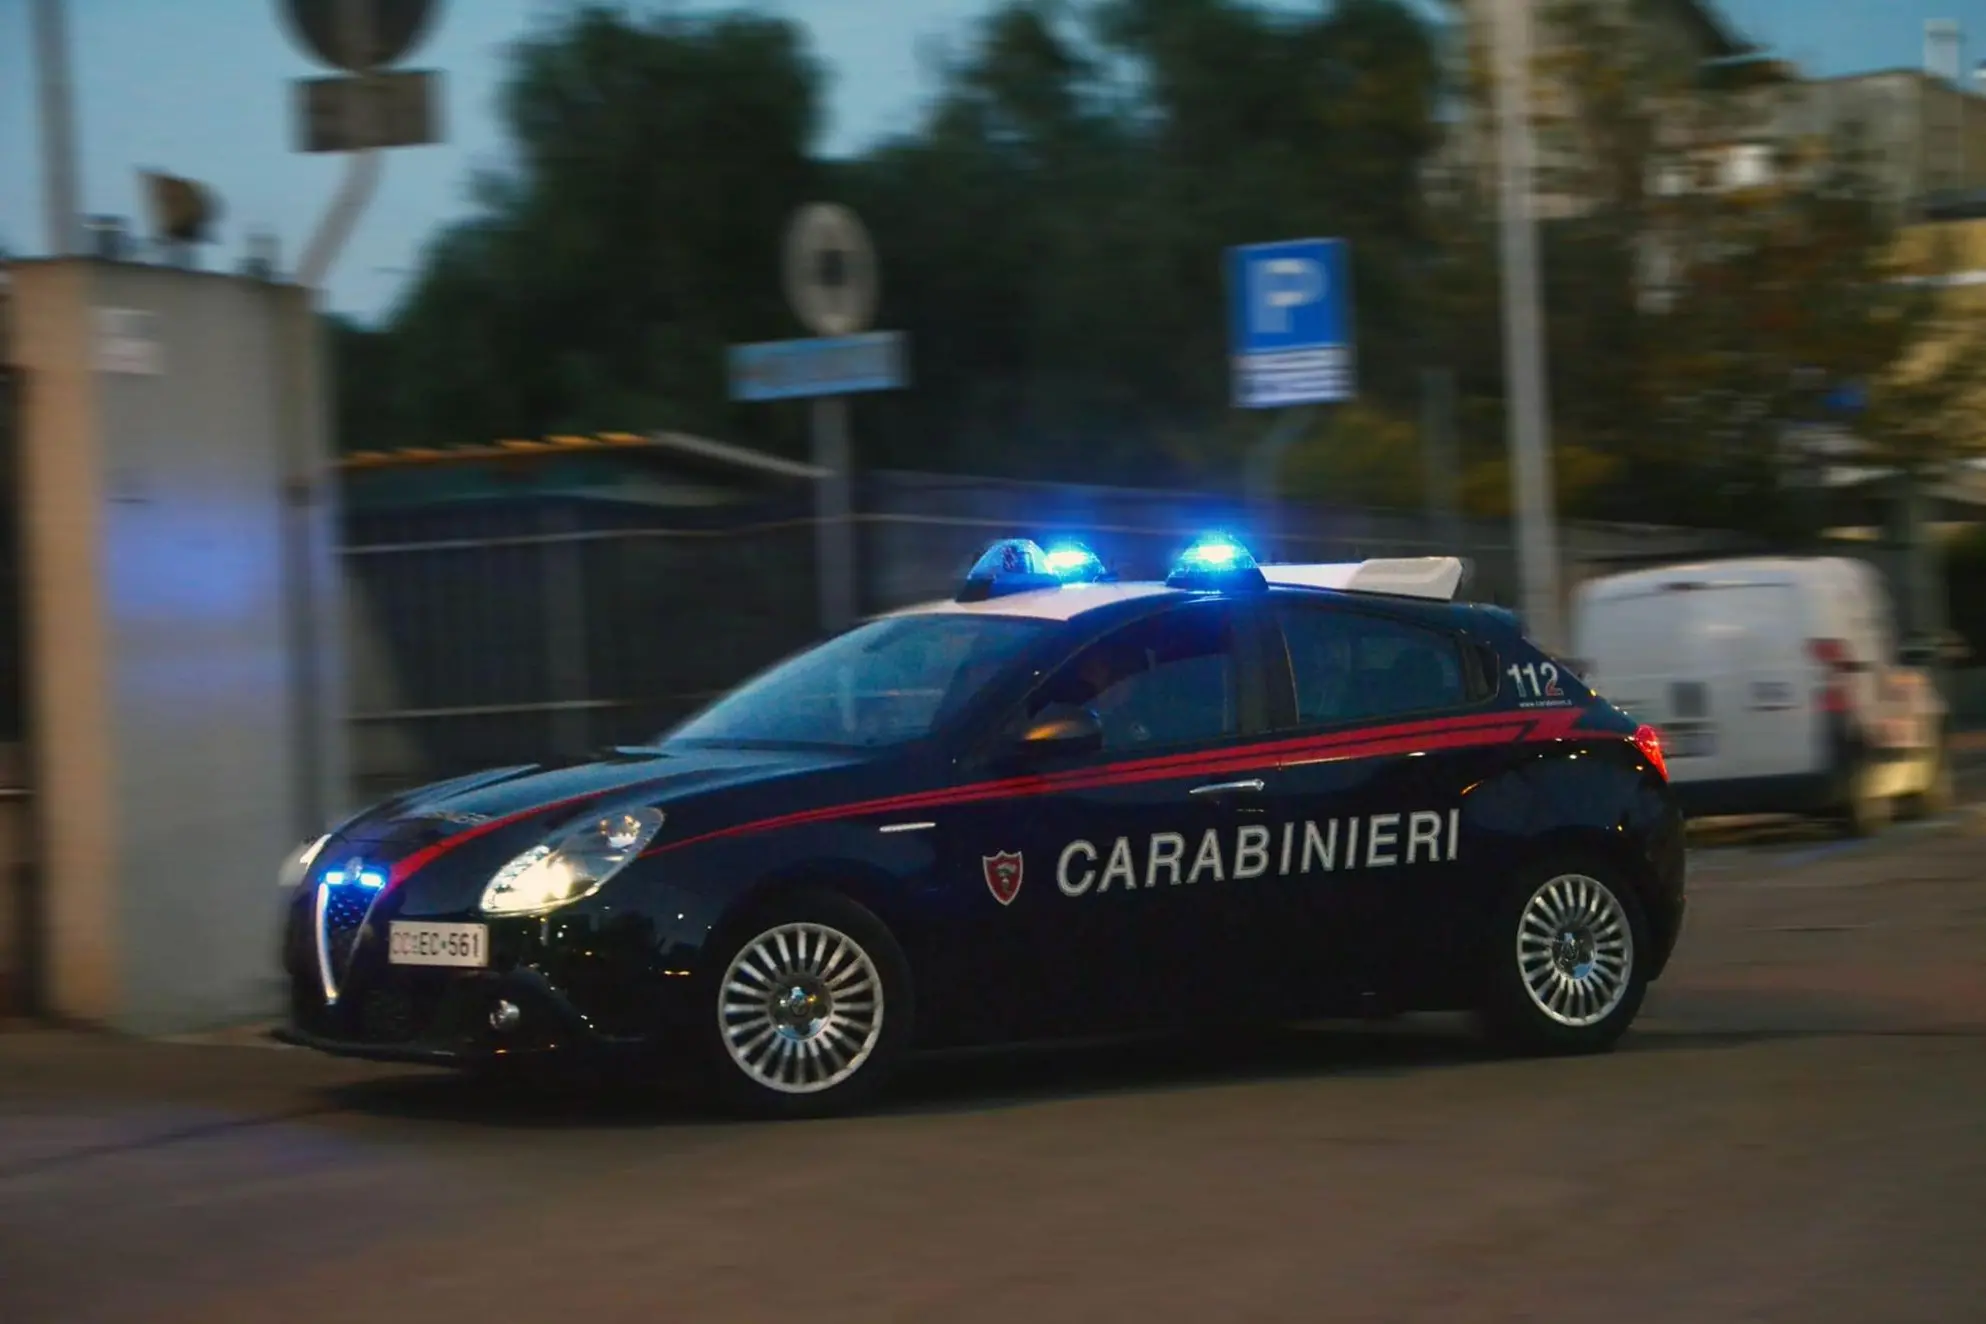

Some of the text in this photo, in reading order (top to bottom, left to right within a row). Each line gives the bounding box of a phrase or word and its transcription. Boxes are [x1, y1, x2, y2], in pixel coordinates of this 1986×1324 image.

[1247, 257, 1330, 334] P
[1507, 662, 1564, 697] 112
[1056, 808, 1461, 897] CARABINIERI
[449, 932, 479, 957] 561
